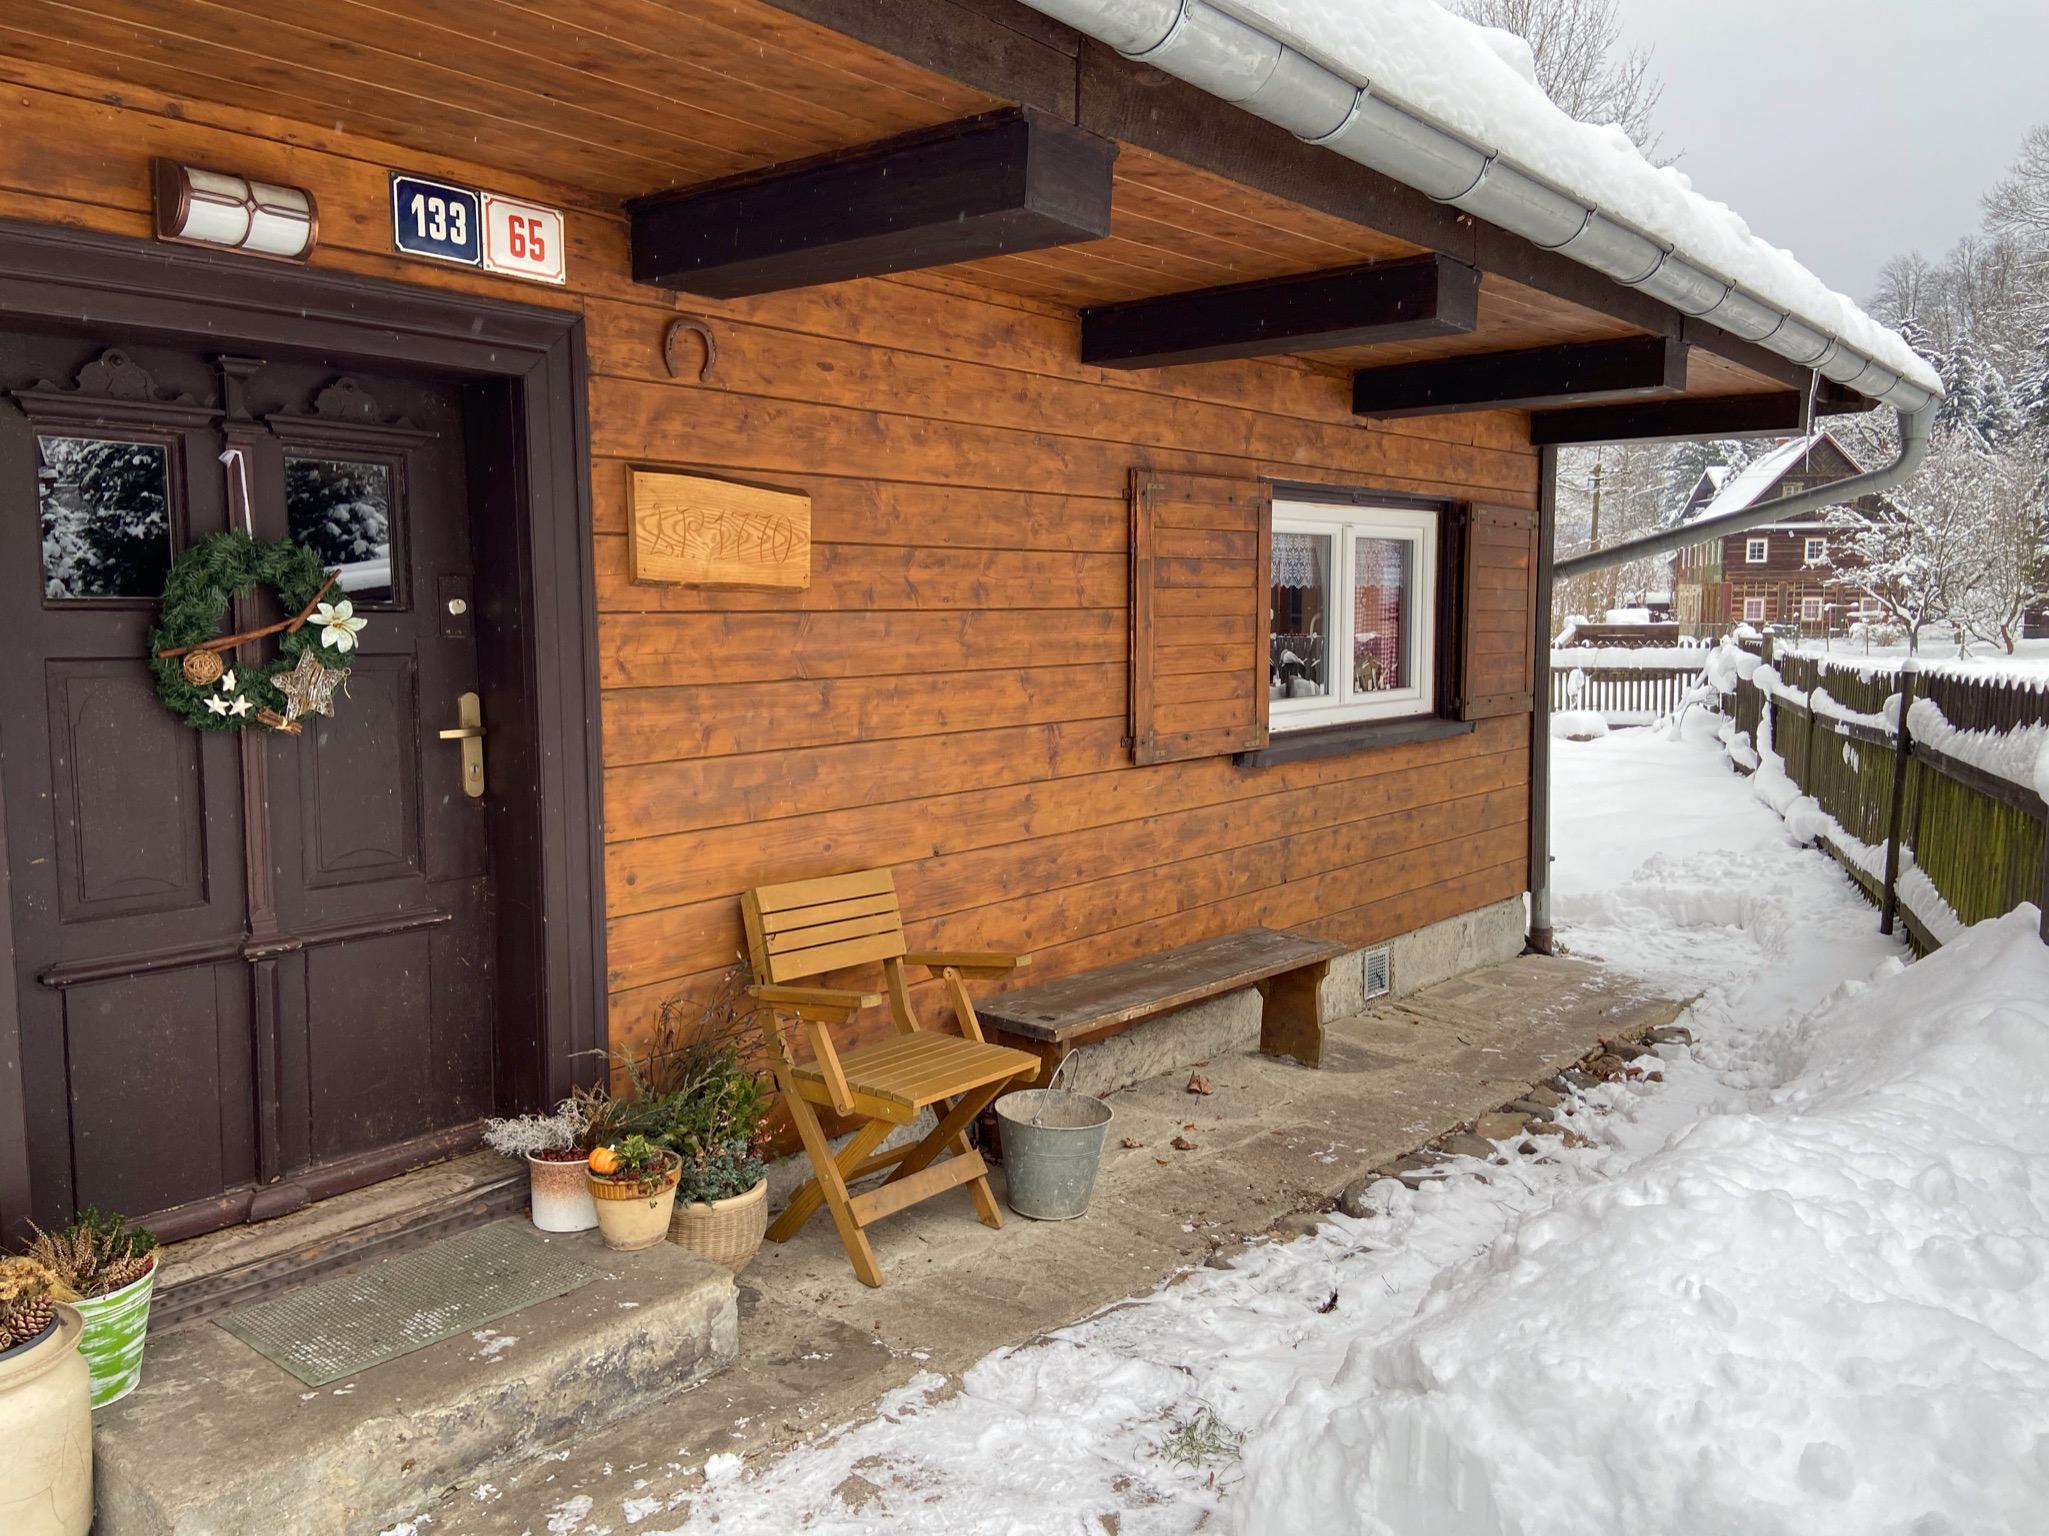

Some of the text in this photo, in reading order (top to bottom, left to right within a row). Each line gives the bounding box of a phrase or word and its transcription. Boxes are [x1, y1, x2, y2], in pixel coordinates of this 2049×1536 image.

[411, 193, 467, 245] 133
[508, 214, 545, 262] 65
[713, 509, 793, 565] 1770
